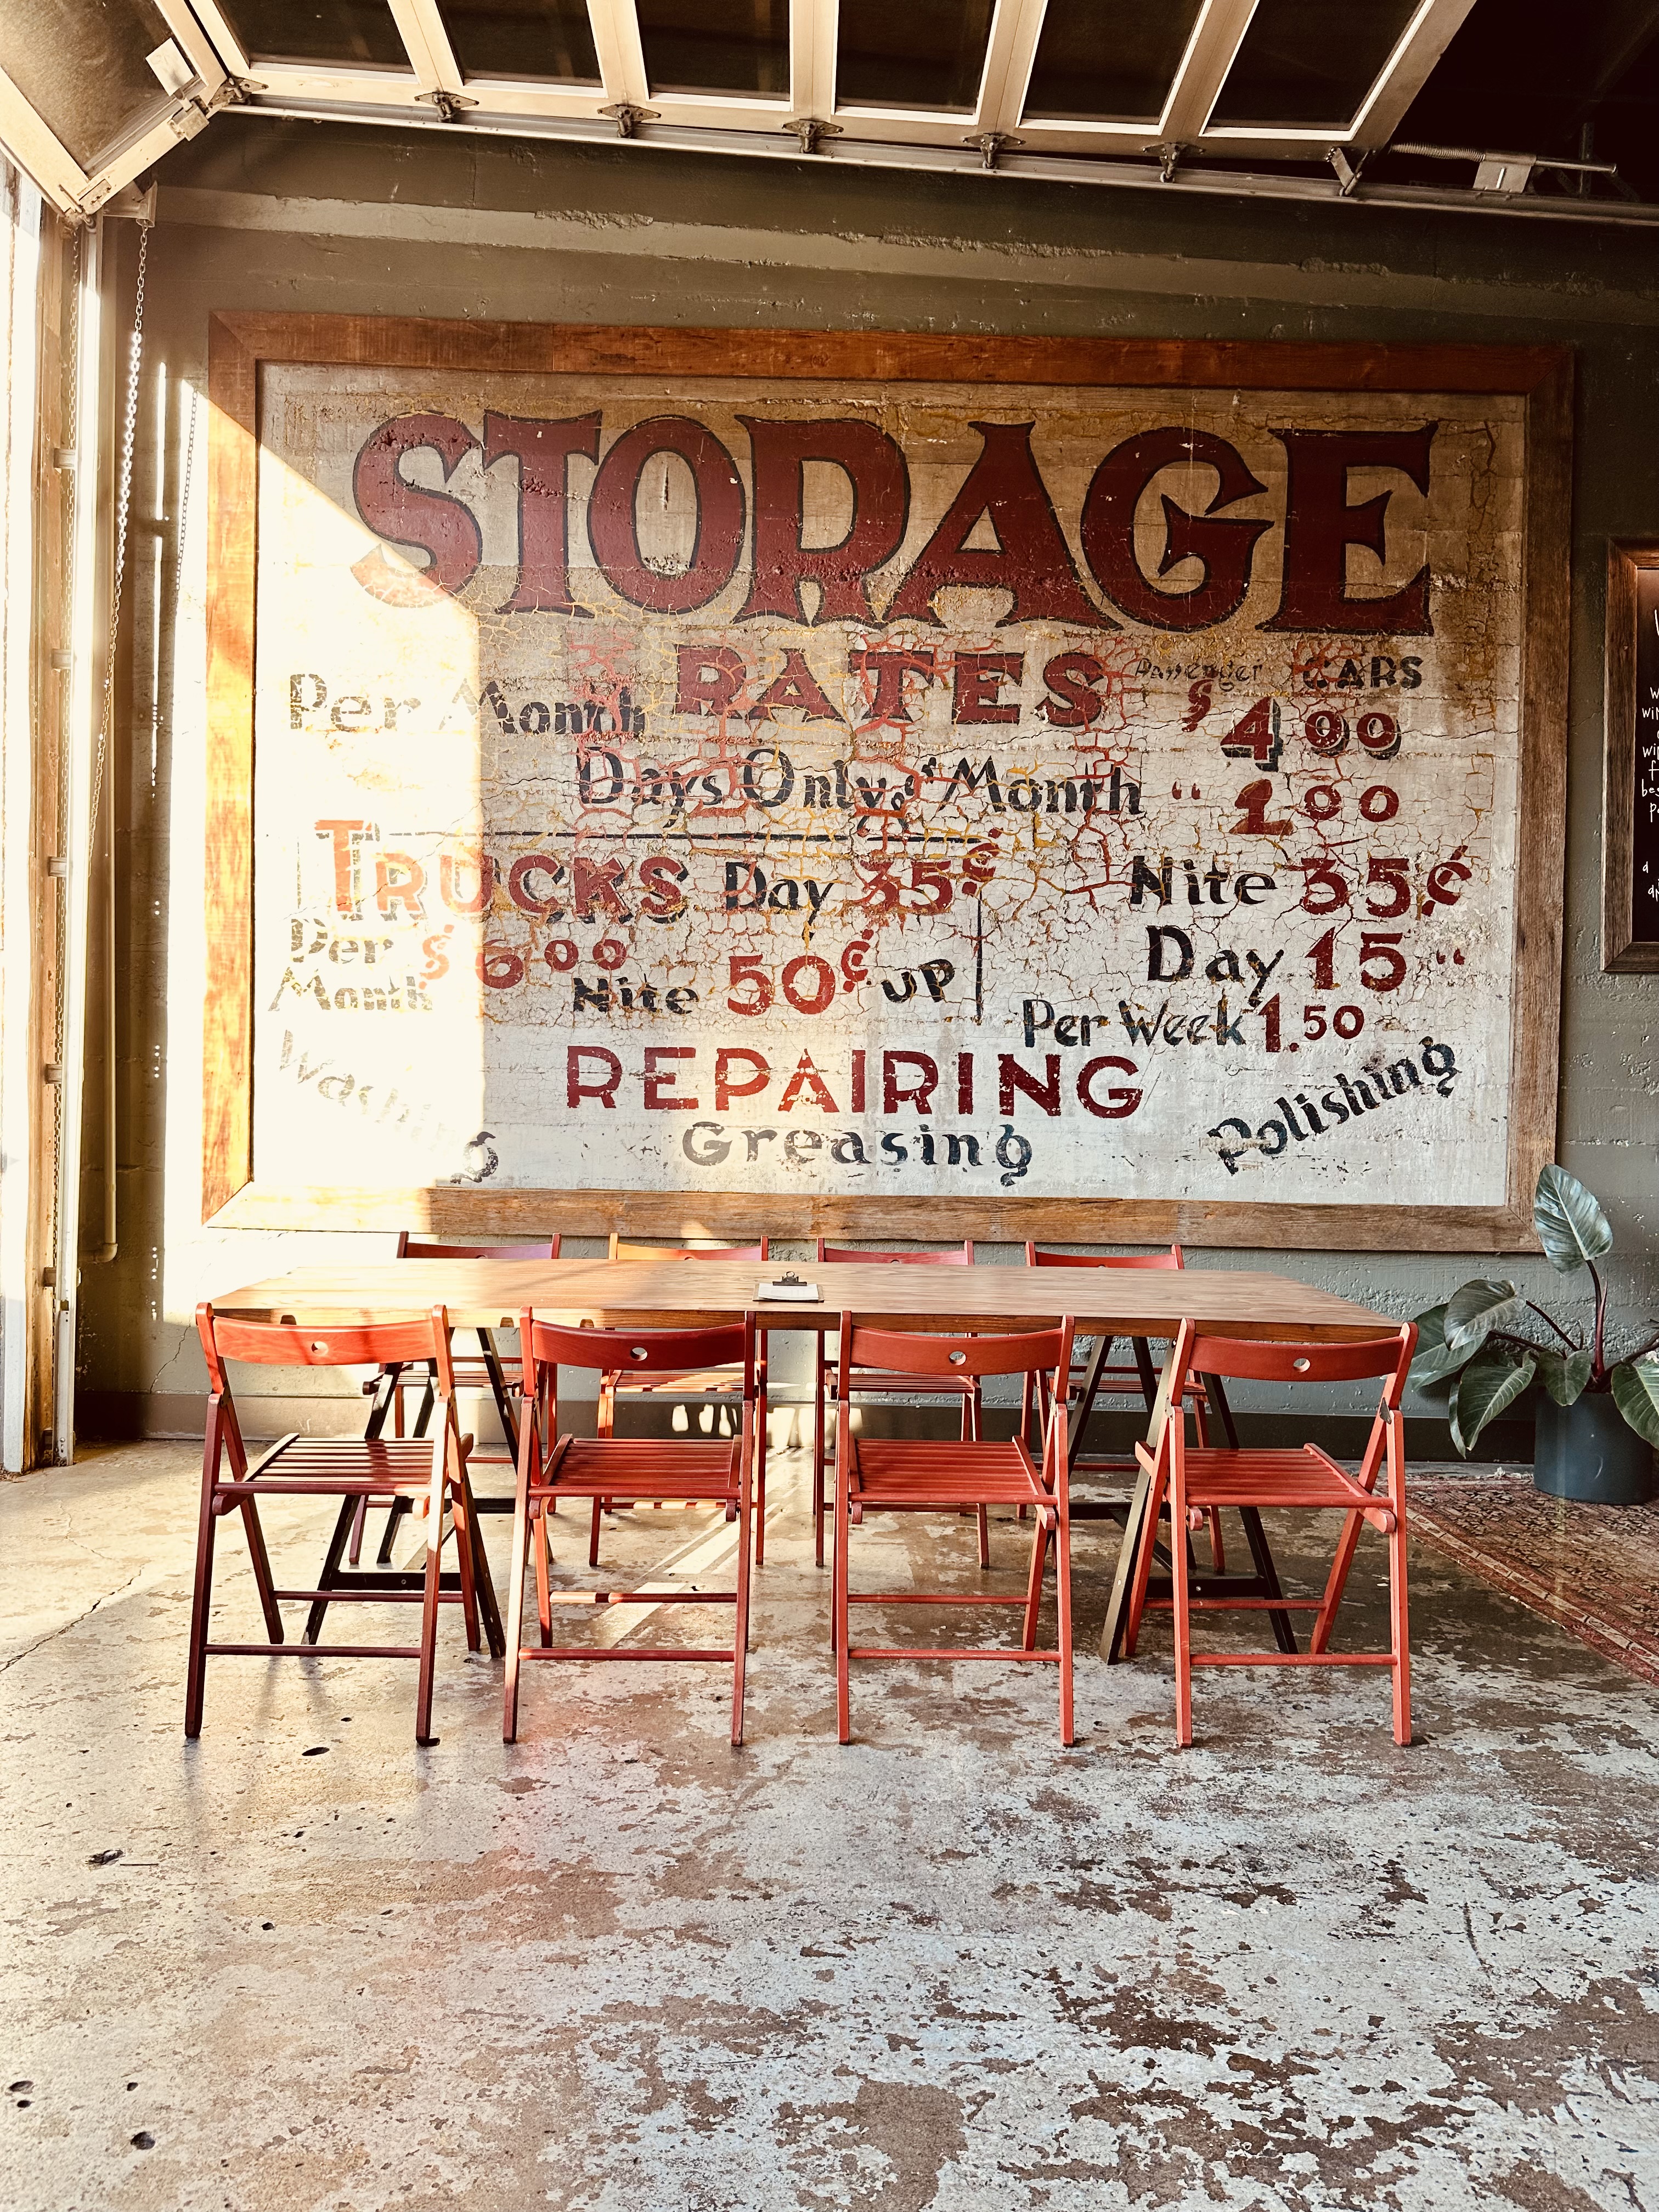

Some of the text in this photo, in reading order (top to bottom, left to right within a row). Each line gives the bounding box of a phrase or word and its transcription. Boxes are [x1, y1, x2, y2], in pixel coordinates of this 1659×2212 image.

[349, 409, 1439, 636] STORAGE
[290, 673, 421, 733] Per
[674, 643, 1103, 727] RATES
[1302, 656, 1424, 690] CARS
[577, 746, 723, 828] Days
[743, 748, 887, 831] Only
[935, 755, 1146, 815] Month
[314, 819, 690, 924] TRUCKS
[726, 861, 843, 941] Day
[1130, 855, 1278, 905] Nite
[291, 918, 394, 964] Per
[1147, 925, 1284, 1007] Day
[1306, 926, 1407, 992] 15
[268, 967, 433, 1012] Month
[573, 973, 699, 1015] Nite
[1023, 998, 1111, 1048] Per
[1118, 989, 1247, 1047] Week
[567, 1046, 1143, 1119] REPAIRING
[1207, 1036, 1460, 1176] Polishing
[682, 1121, 1032, 1187] Greasing
